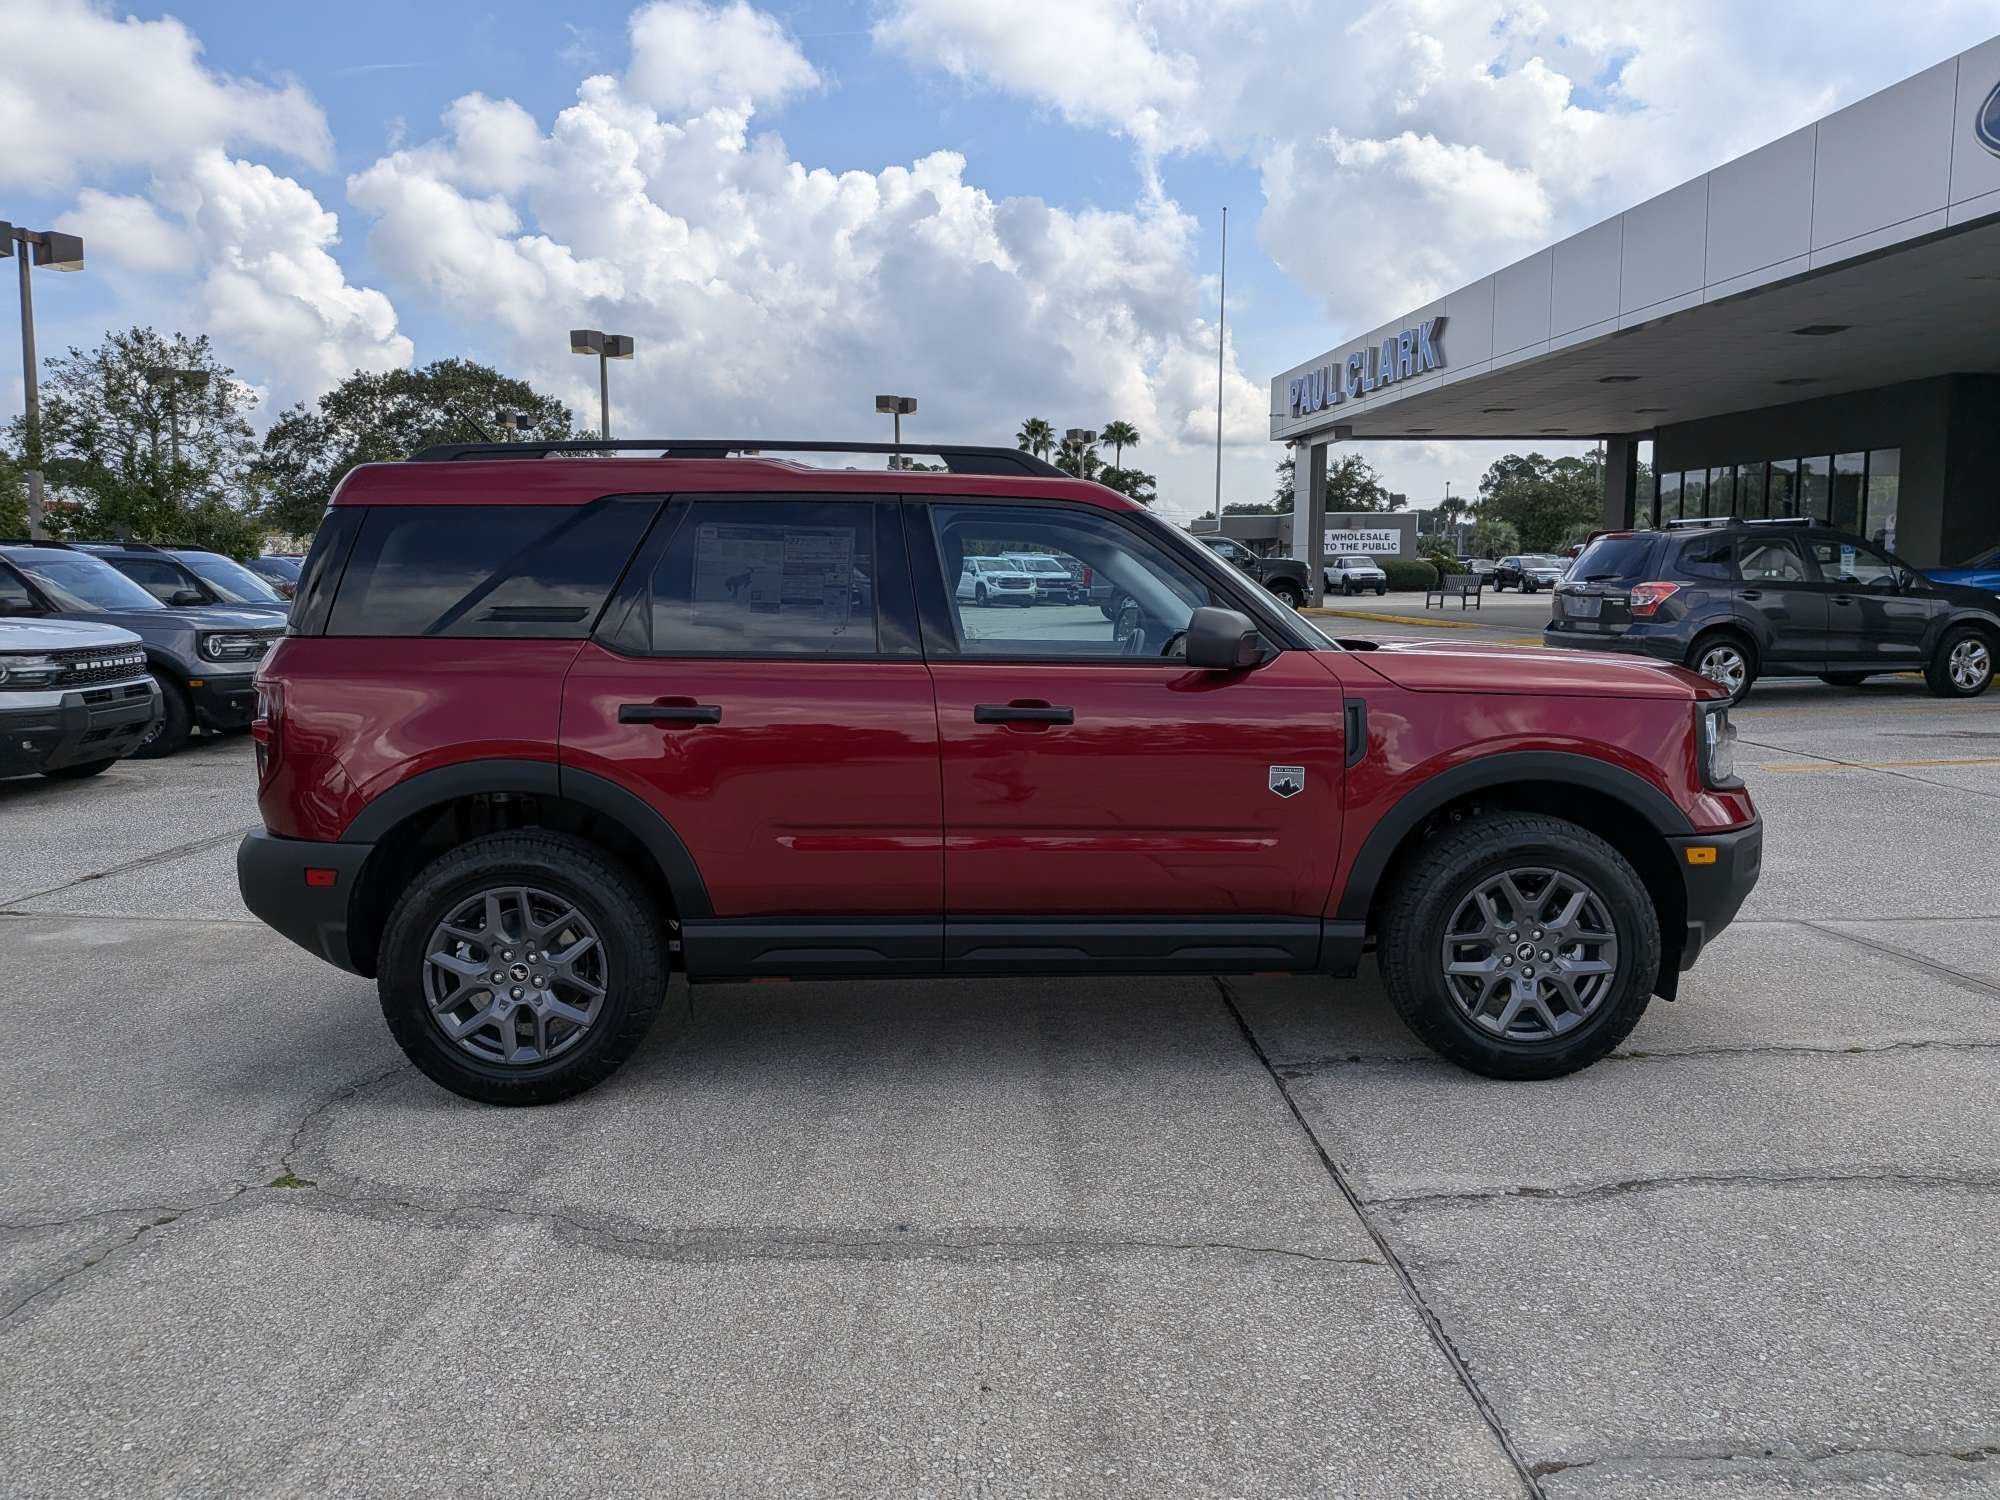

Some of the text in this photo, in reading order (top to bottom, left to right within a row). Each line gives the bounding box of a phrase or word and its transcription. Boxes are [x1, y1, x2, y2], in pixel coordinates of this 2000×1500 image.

[1289, 318, 1444, 414] PAUL CLARK
[1331, 533, 1390, 541] WHOLESALE
[1324, 542, 1397, 551] TO THE PUBLIC
[75, 657, 142, 670] BRONCO
